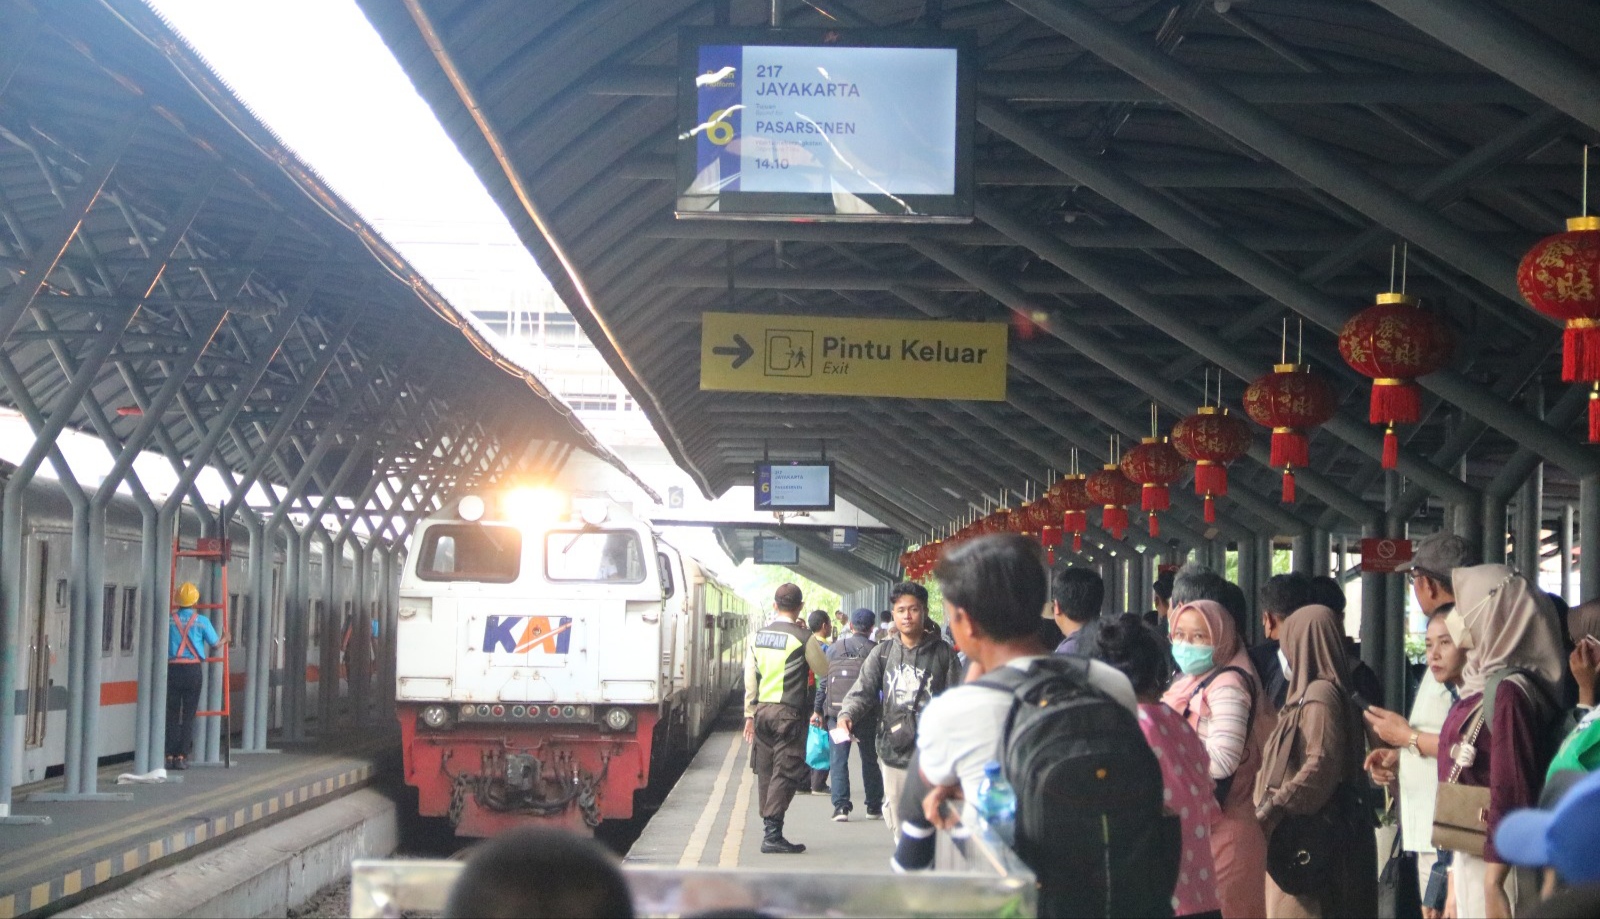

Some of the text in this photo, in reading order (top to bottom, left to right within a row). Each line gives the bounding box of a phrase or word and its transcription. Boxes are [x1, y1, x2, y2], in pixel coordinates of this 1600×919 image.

[756, 65, 783, 78] 217
[756, 82, 861, 97] JAYAKARTA
[706, 109, 735, 146] 6
[755, 121, 856, 135] PASARSENEN
[755, 158, 789, 170] 14.10
[822, 336, 988, 364] Pintu Keluar
[822, 361, 850, 375] Exit
[761, 483, 770, 493] 6
[671, 490, 683, 506] 6
[482, 615, 573, 654] KAI
[756, 632, 787, 648] SATPAM
